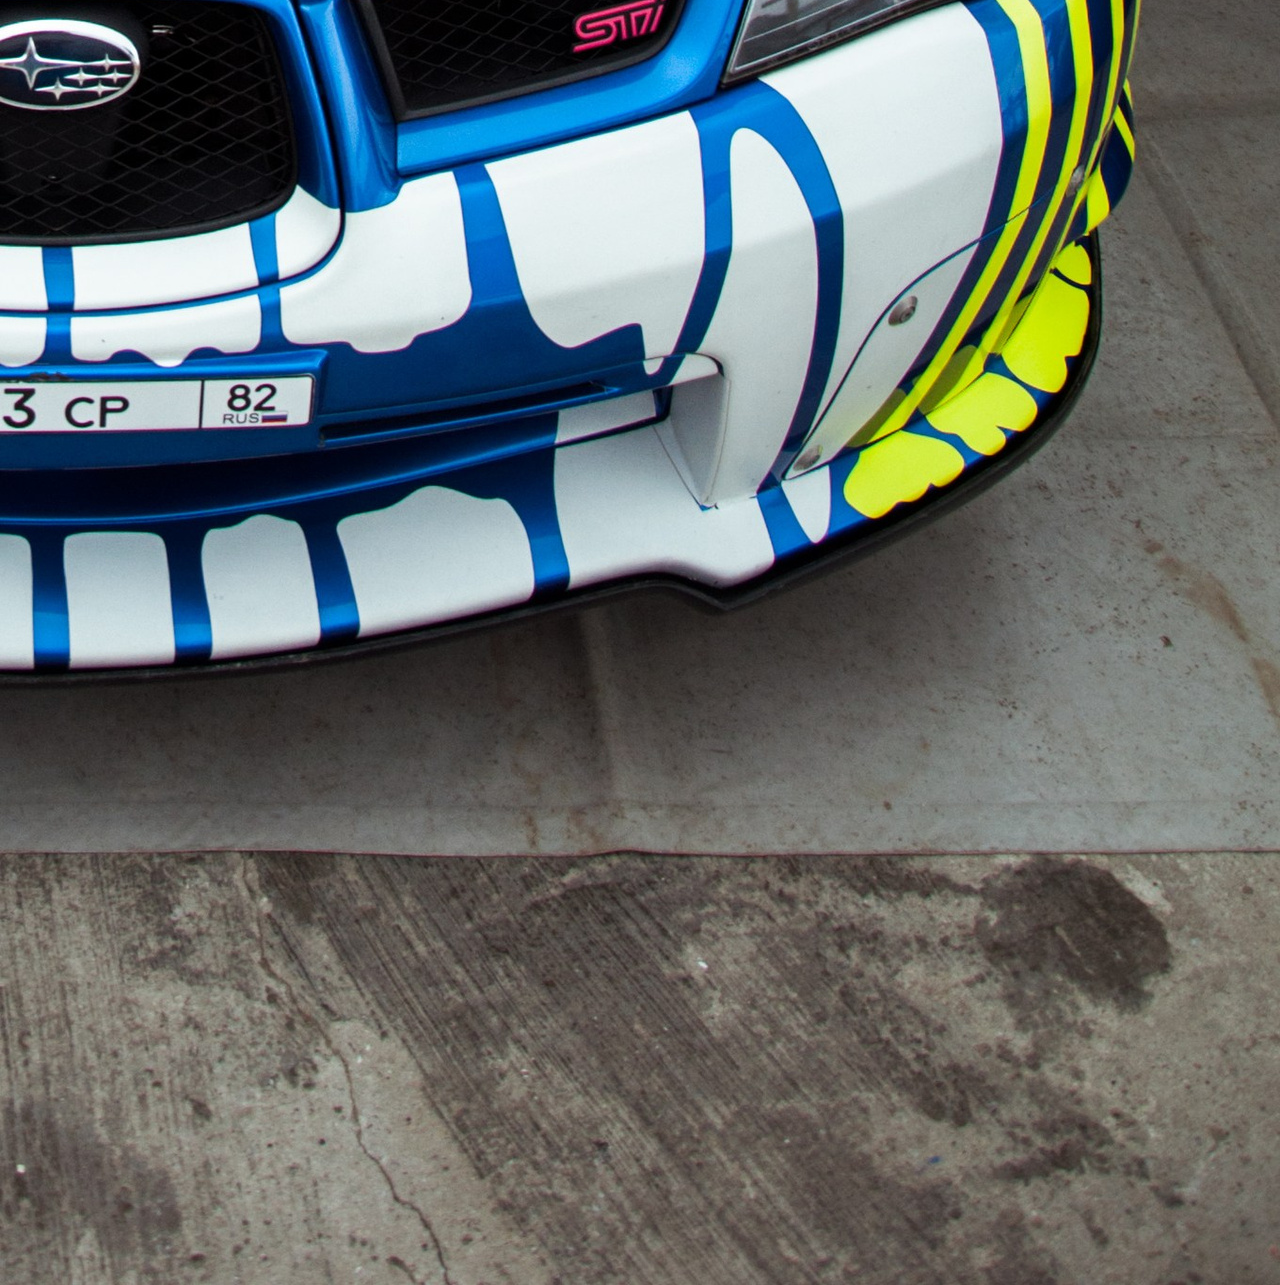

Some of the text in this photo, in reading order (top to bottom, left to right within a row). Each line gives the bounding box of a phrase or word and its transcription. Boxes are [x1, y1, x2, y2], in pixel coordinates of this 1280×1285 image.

[64, 395, 131, 429] CP
[226, 383, 278, 412] 82
[222, 412, 260, 425] RUS
